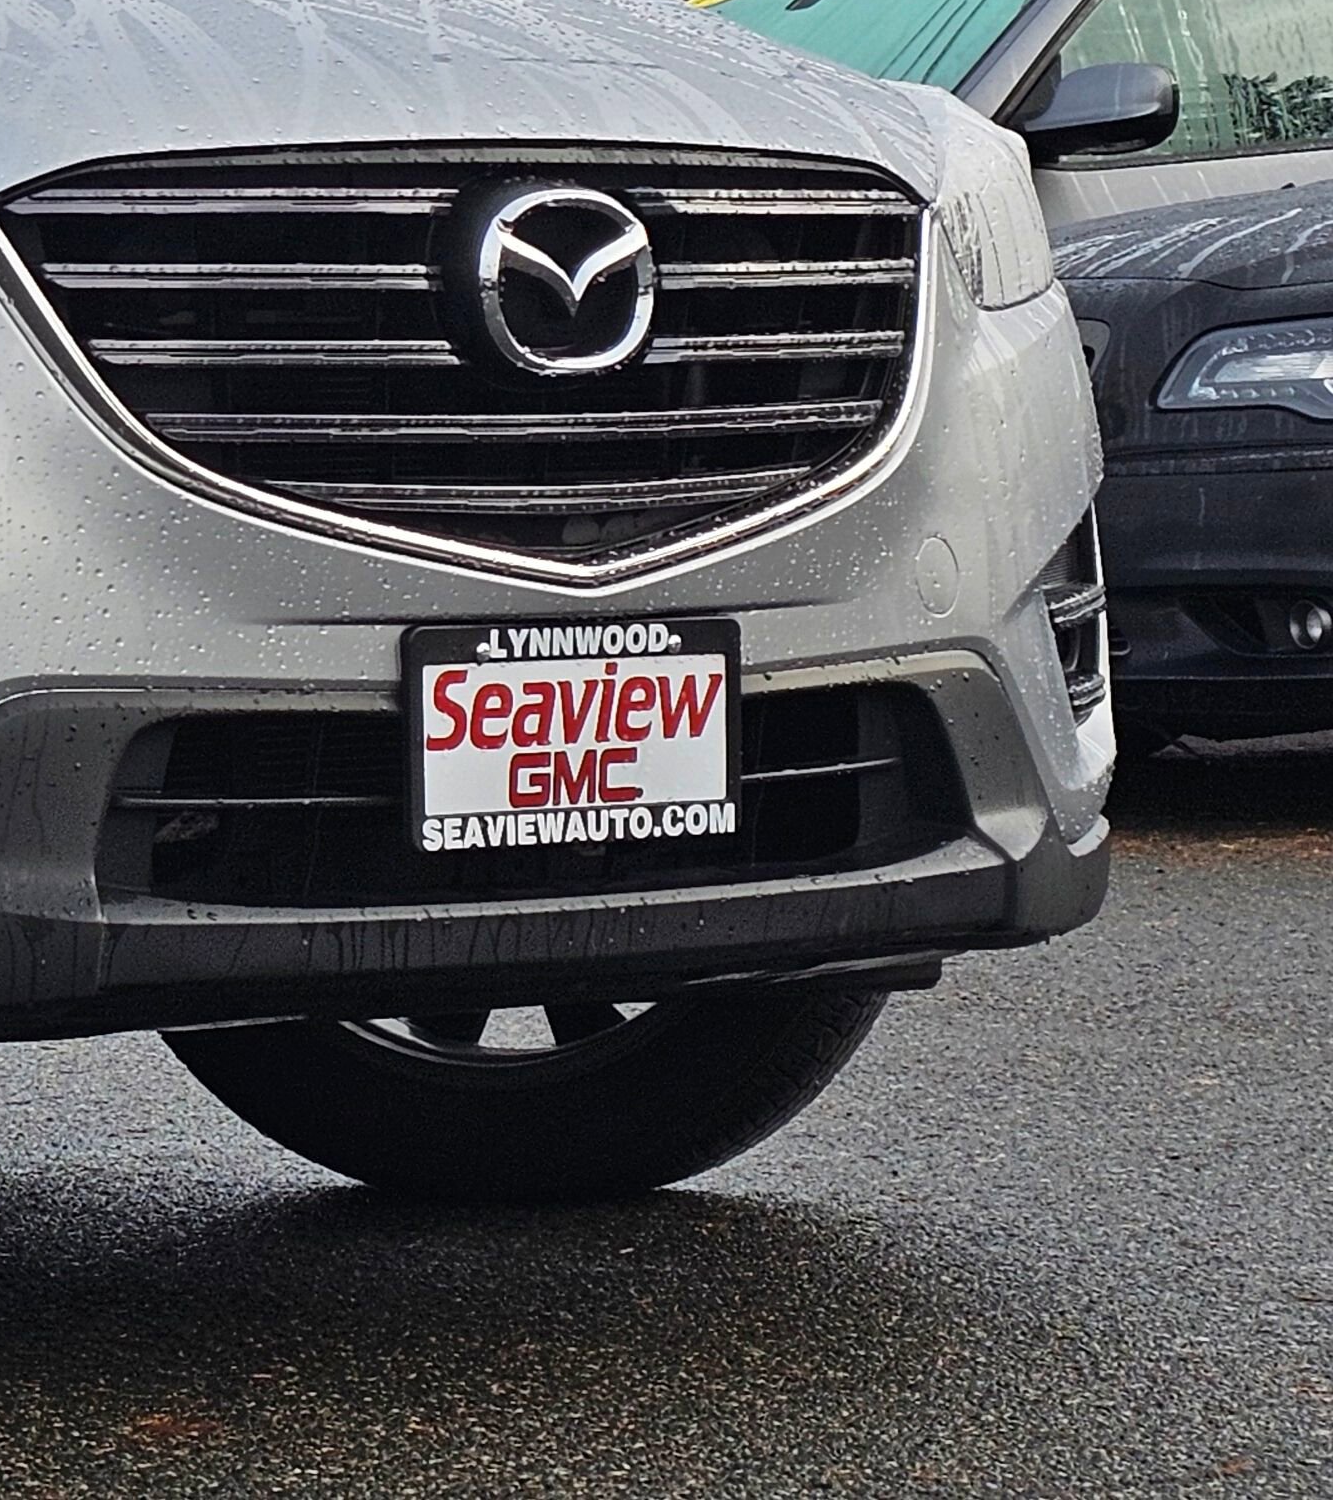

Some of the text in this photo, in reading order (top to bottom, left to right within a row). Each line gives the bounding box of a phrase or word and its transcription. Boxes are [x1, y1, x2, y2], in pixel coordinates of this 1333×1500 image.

[489, 624, 670, 659] LYNNWOOD
[425, 662, 724, 752] Seaview
[508, 747, 643, 808] GMC
[422, 803, 736, 852] SEAVIEWAUTO.COM
